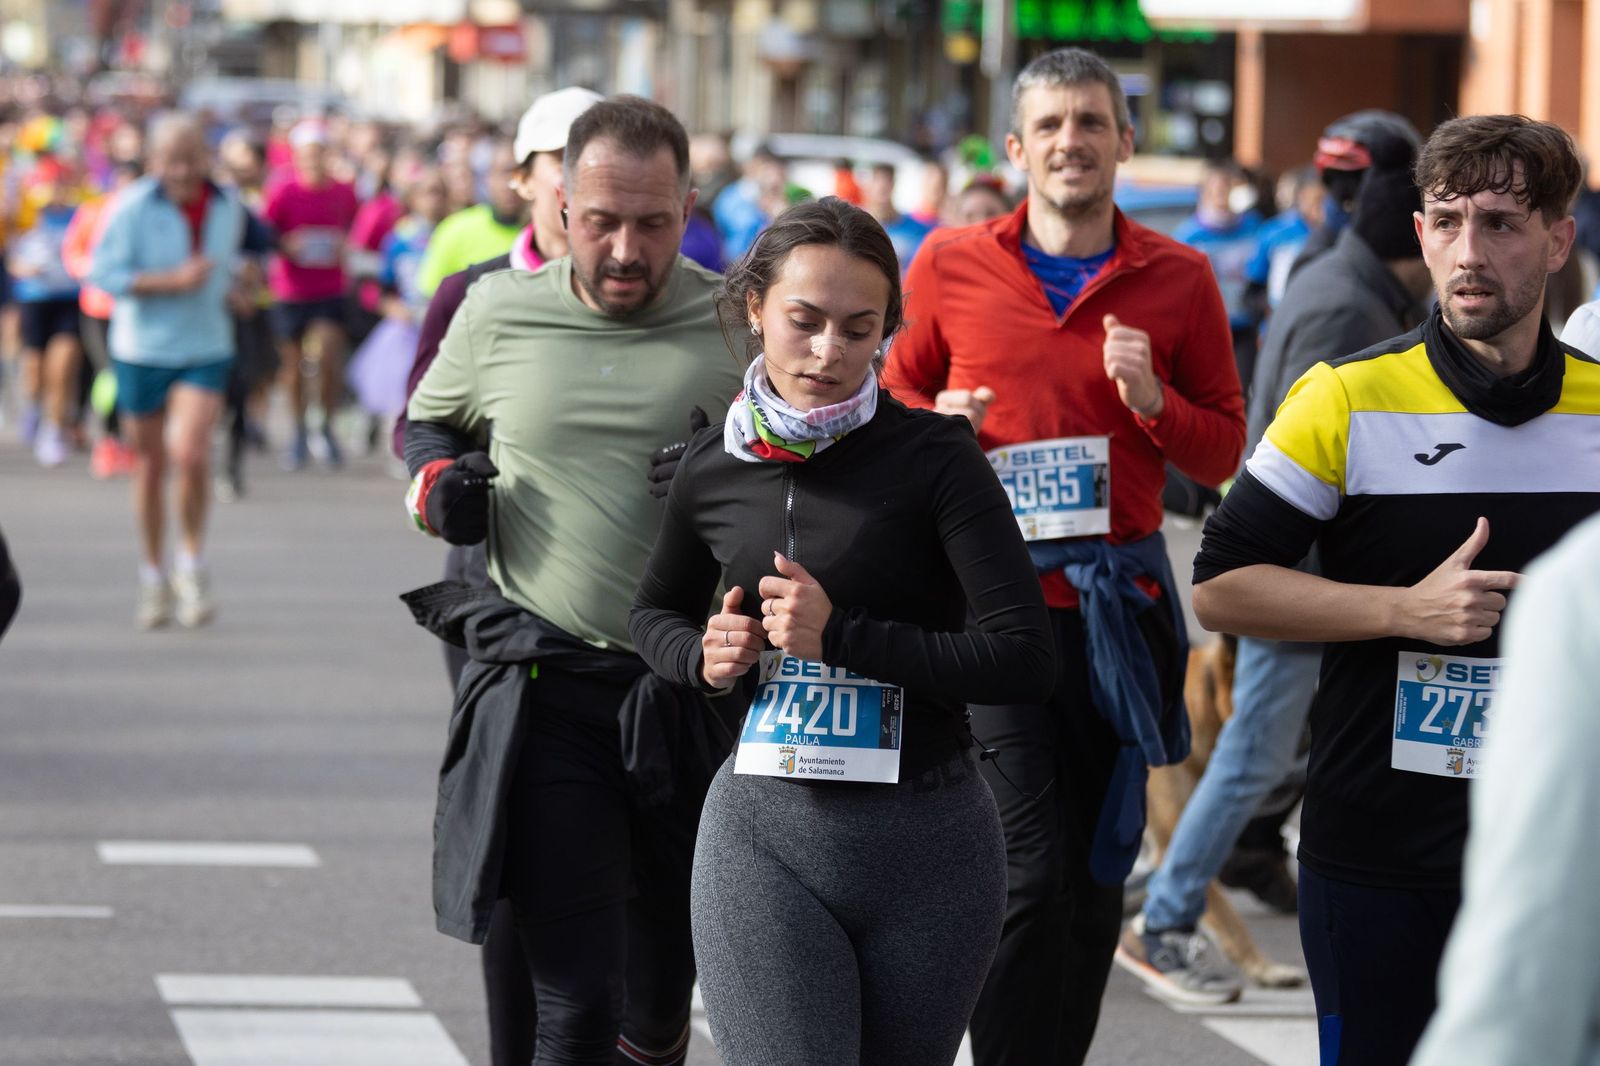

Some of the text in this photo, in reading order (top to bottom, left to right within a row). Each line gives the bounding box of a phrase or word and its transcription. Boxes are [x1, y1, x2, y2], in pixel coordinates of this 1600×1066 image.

[1011, 446, 1095, 466] SETEL
[756, 683, 857, 736] 2420
[1419, 686, 1491, 738] 273
[785, 734, 820, 745] PAULA
[1453, 737, 1481, 748] GABR
[798, 756, 846, 766] Ayuntamiento
[798, 766, 845, 776] de Salamanca
